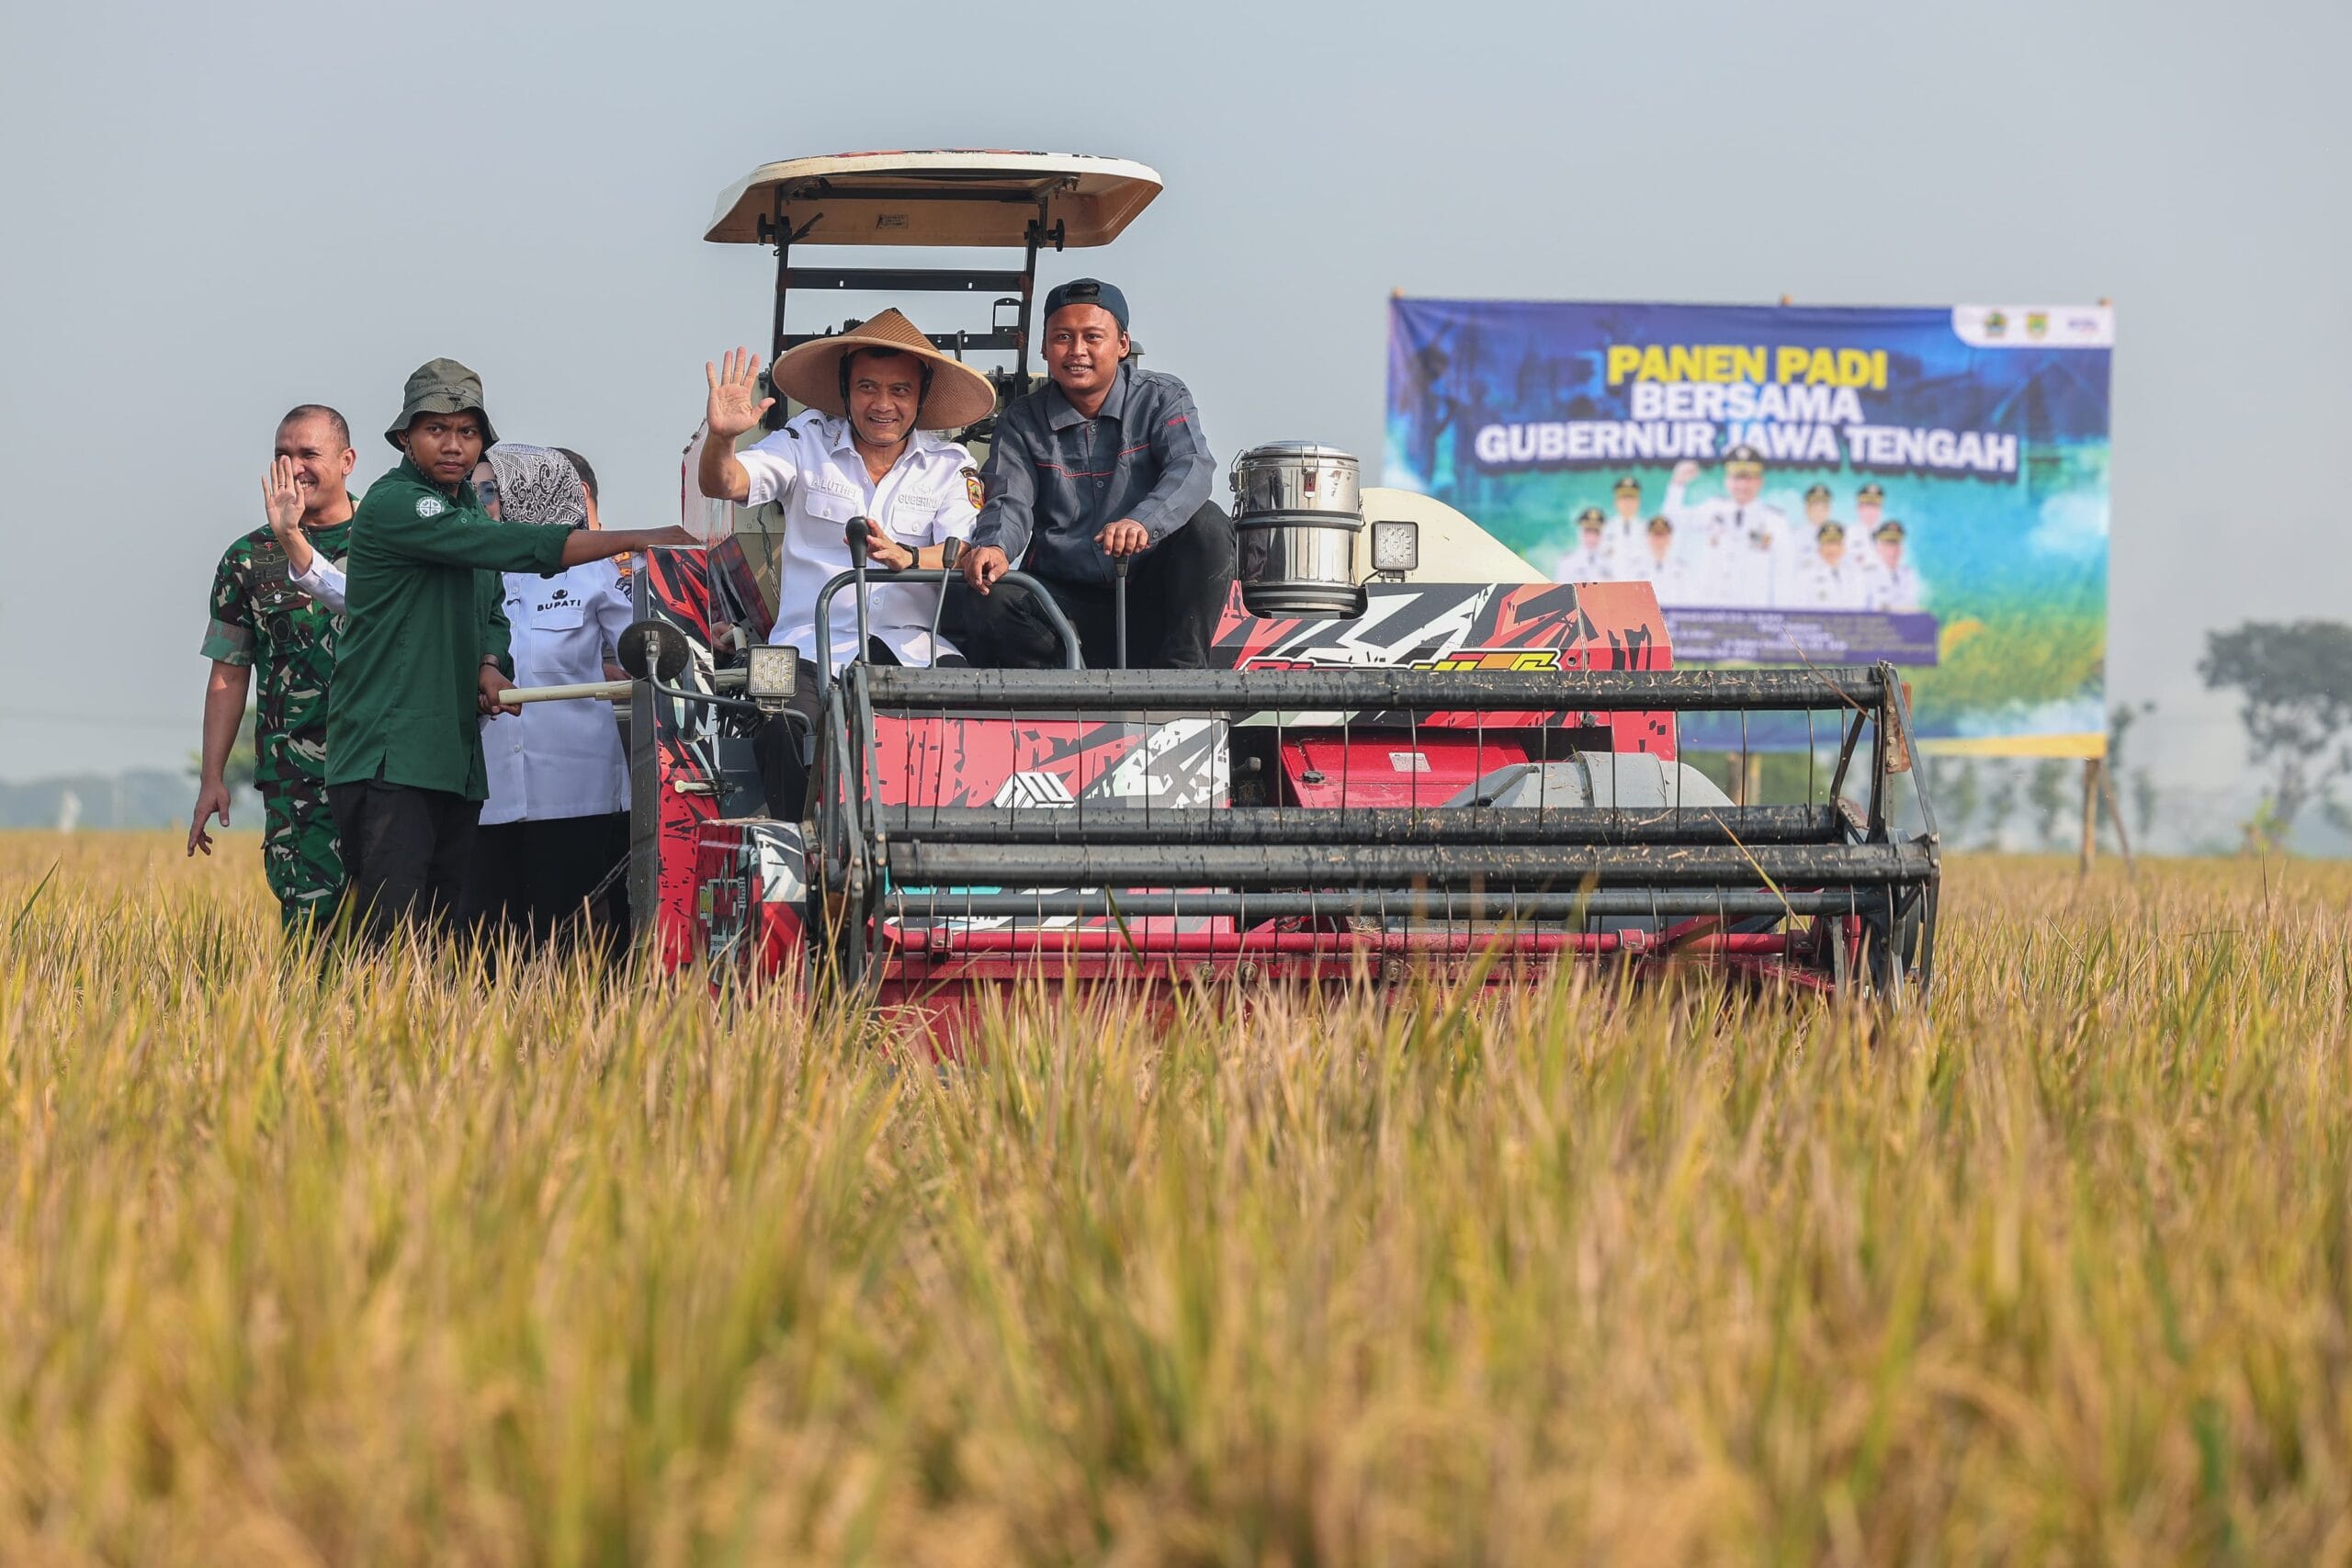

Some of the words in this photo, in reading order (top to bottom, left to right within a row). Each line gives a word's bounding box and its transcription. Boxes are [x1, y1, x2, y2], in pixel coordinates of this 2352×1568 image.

[1609, 345, 1767, 385] PANEN
[1776, 346, 1888, 389] PADI
[1631, 382, 1865, 423] BERSAMA
[1475, 421, 1715, 463] GUBERNUR
[1720, 423, 1840, 461] JAWA
[1843, 424, 2018, 472] TENGAH
[537, 600, 581, 611] BUPATI
